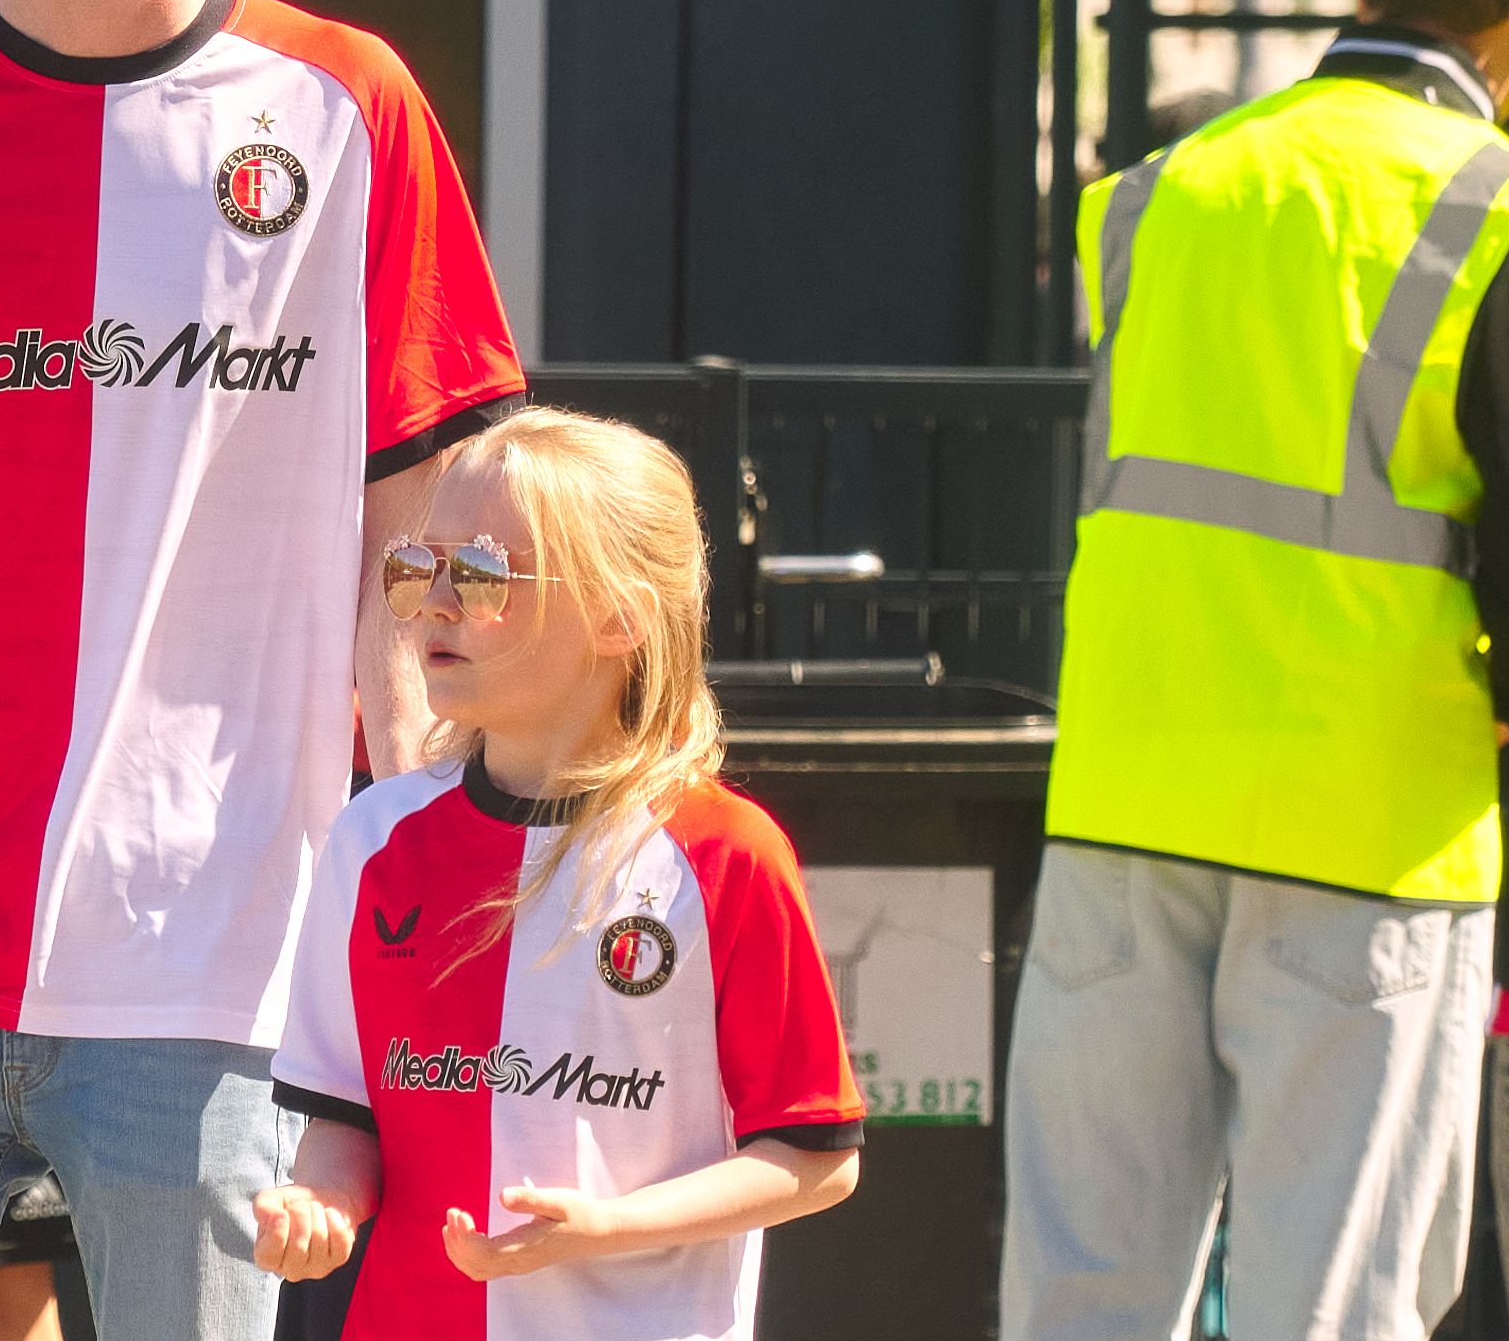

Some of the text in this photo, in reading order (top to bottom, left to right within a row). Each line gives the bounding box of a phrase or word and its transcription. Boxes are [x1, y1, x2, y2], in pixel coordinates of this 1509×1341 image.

[223, 145, 302, 177] FEYENOORD
[135, 321, 316, 393] Markt
[607, 919, 673, 951] FEYENOORD
[380, 1037, 666, 1111] Media Markt
